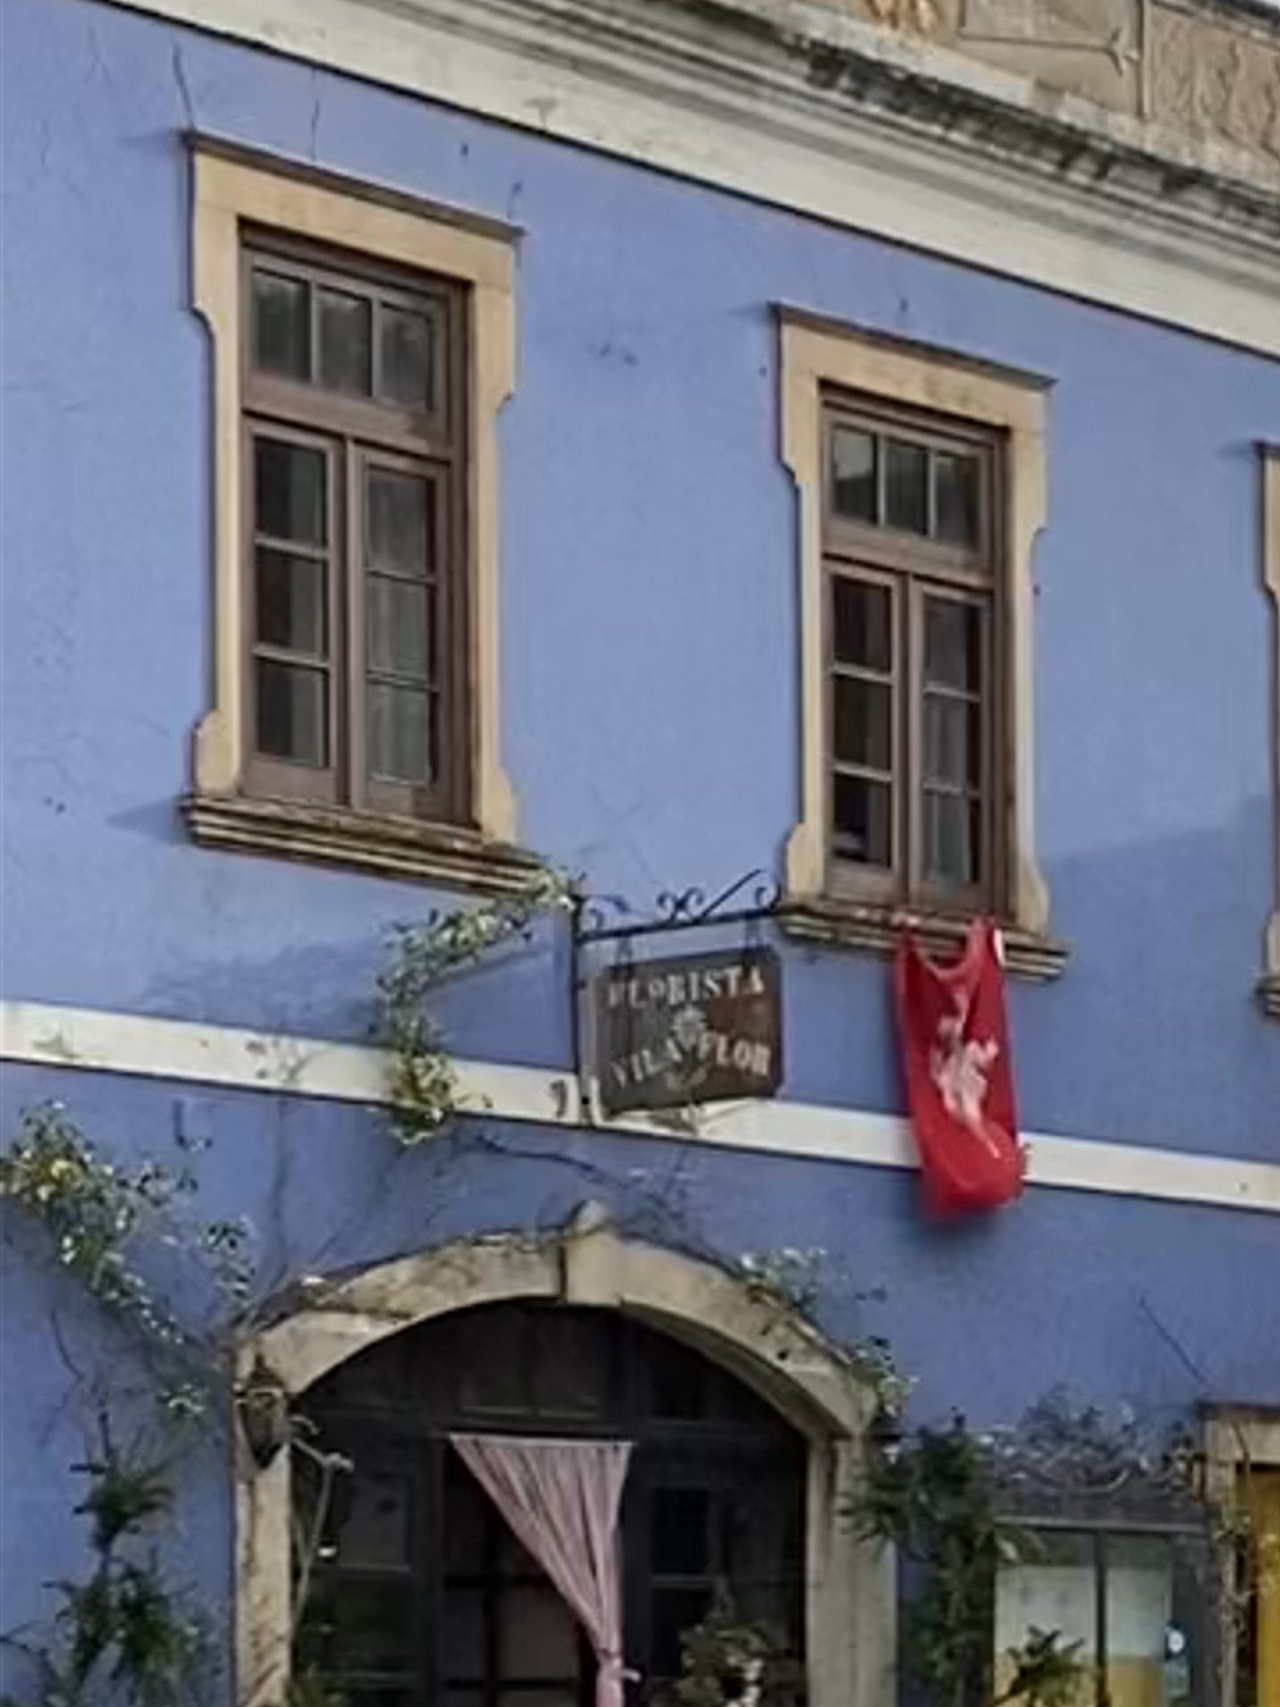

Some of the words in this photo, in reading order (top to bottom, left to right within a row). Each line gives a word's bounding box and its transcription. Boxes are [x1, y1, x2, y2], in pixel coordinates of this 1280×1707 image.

[608, 966, 764, 1008] FLORISTA
[611, 1038, 682, 1087] VILA
[699, 1031, 770, 1077] FLOR
